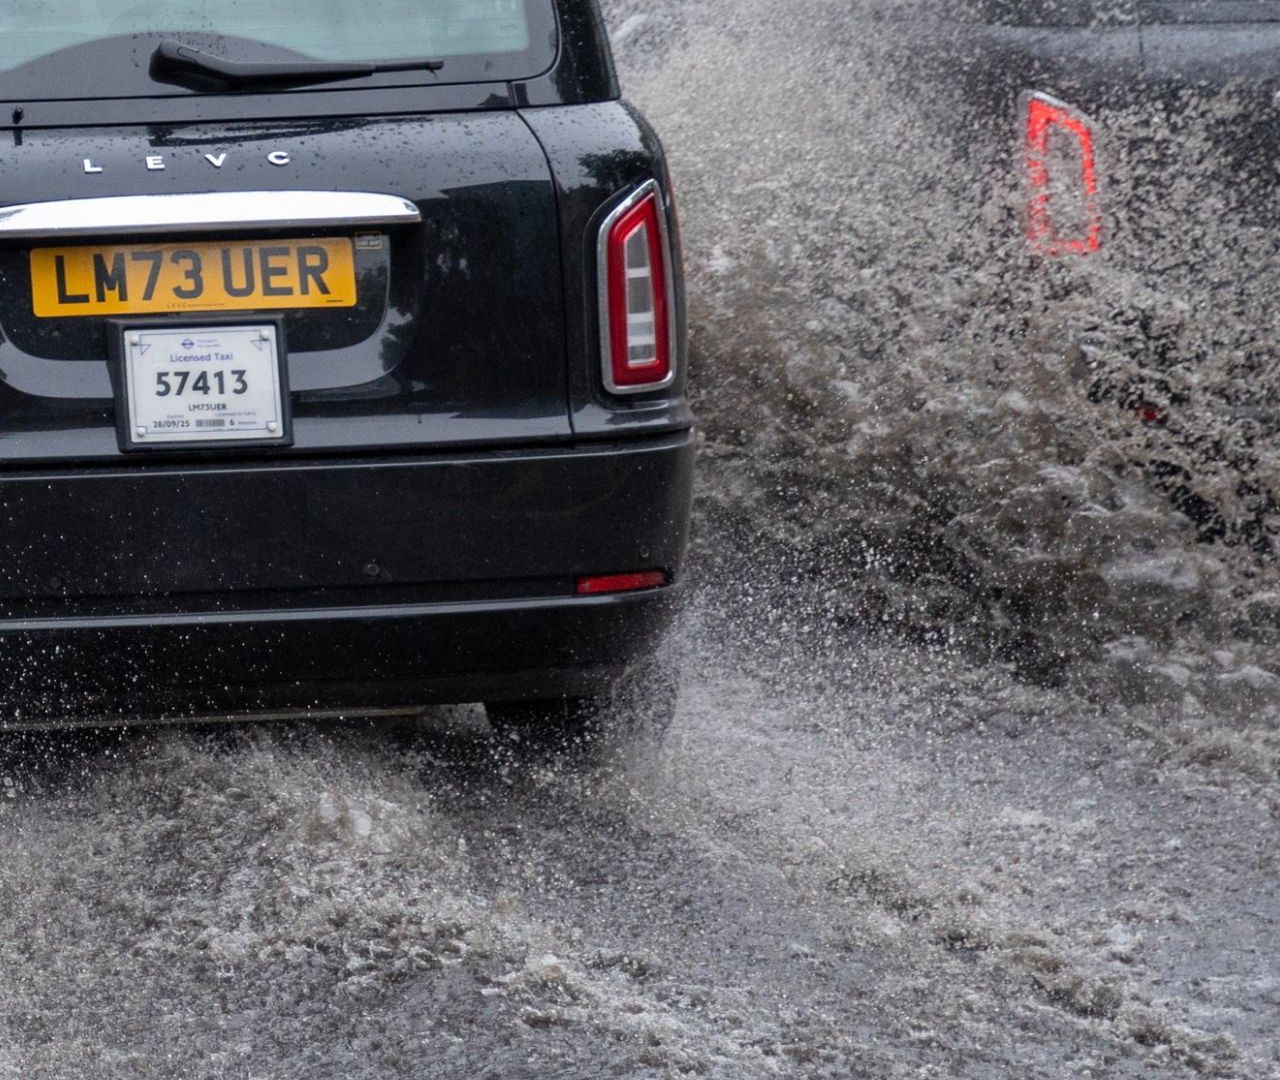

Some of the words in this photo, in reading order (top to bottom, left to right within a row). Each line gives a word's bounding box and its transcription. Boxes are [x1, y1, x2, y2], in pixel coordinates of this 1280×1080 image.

[83, 150, 291, 173] LEVC
[54, 251, 203, 305] LM73
[221, 245, 332, 298] UER
[170, 353, 212, 362] Licensed
[214, 352, 234, 361] Taxi
[155, 370, 248, 397] 57413
[153, 420, 190, 428] 28/09/25
